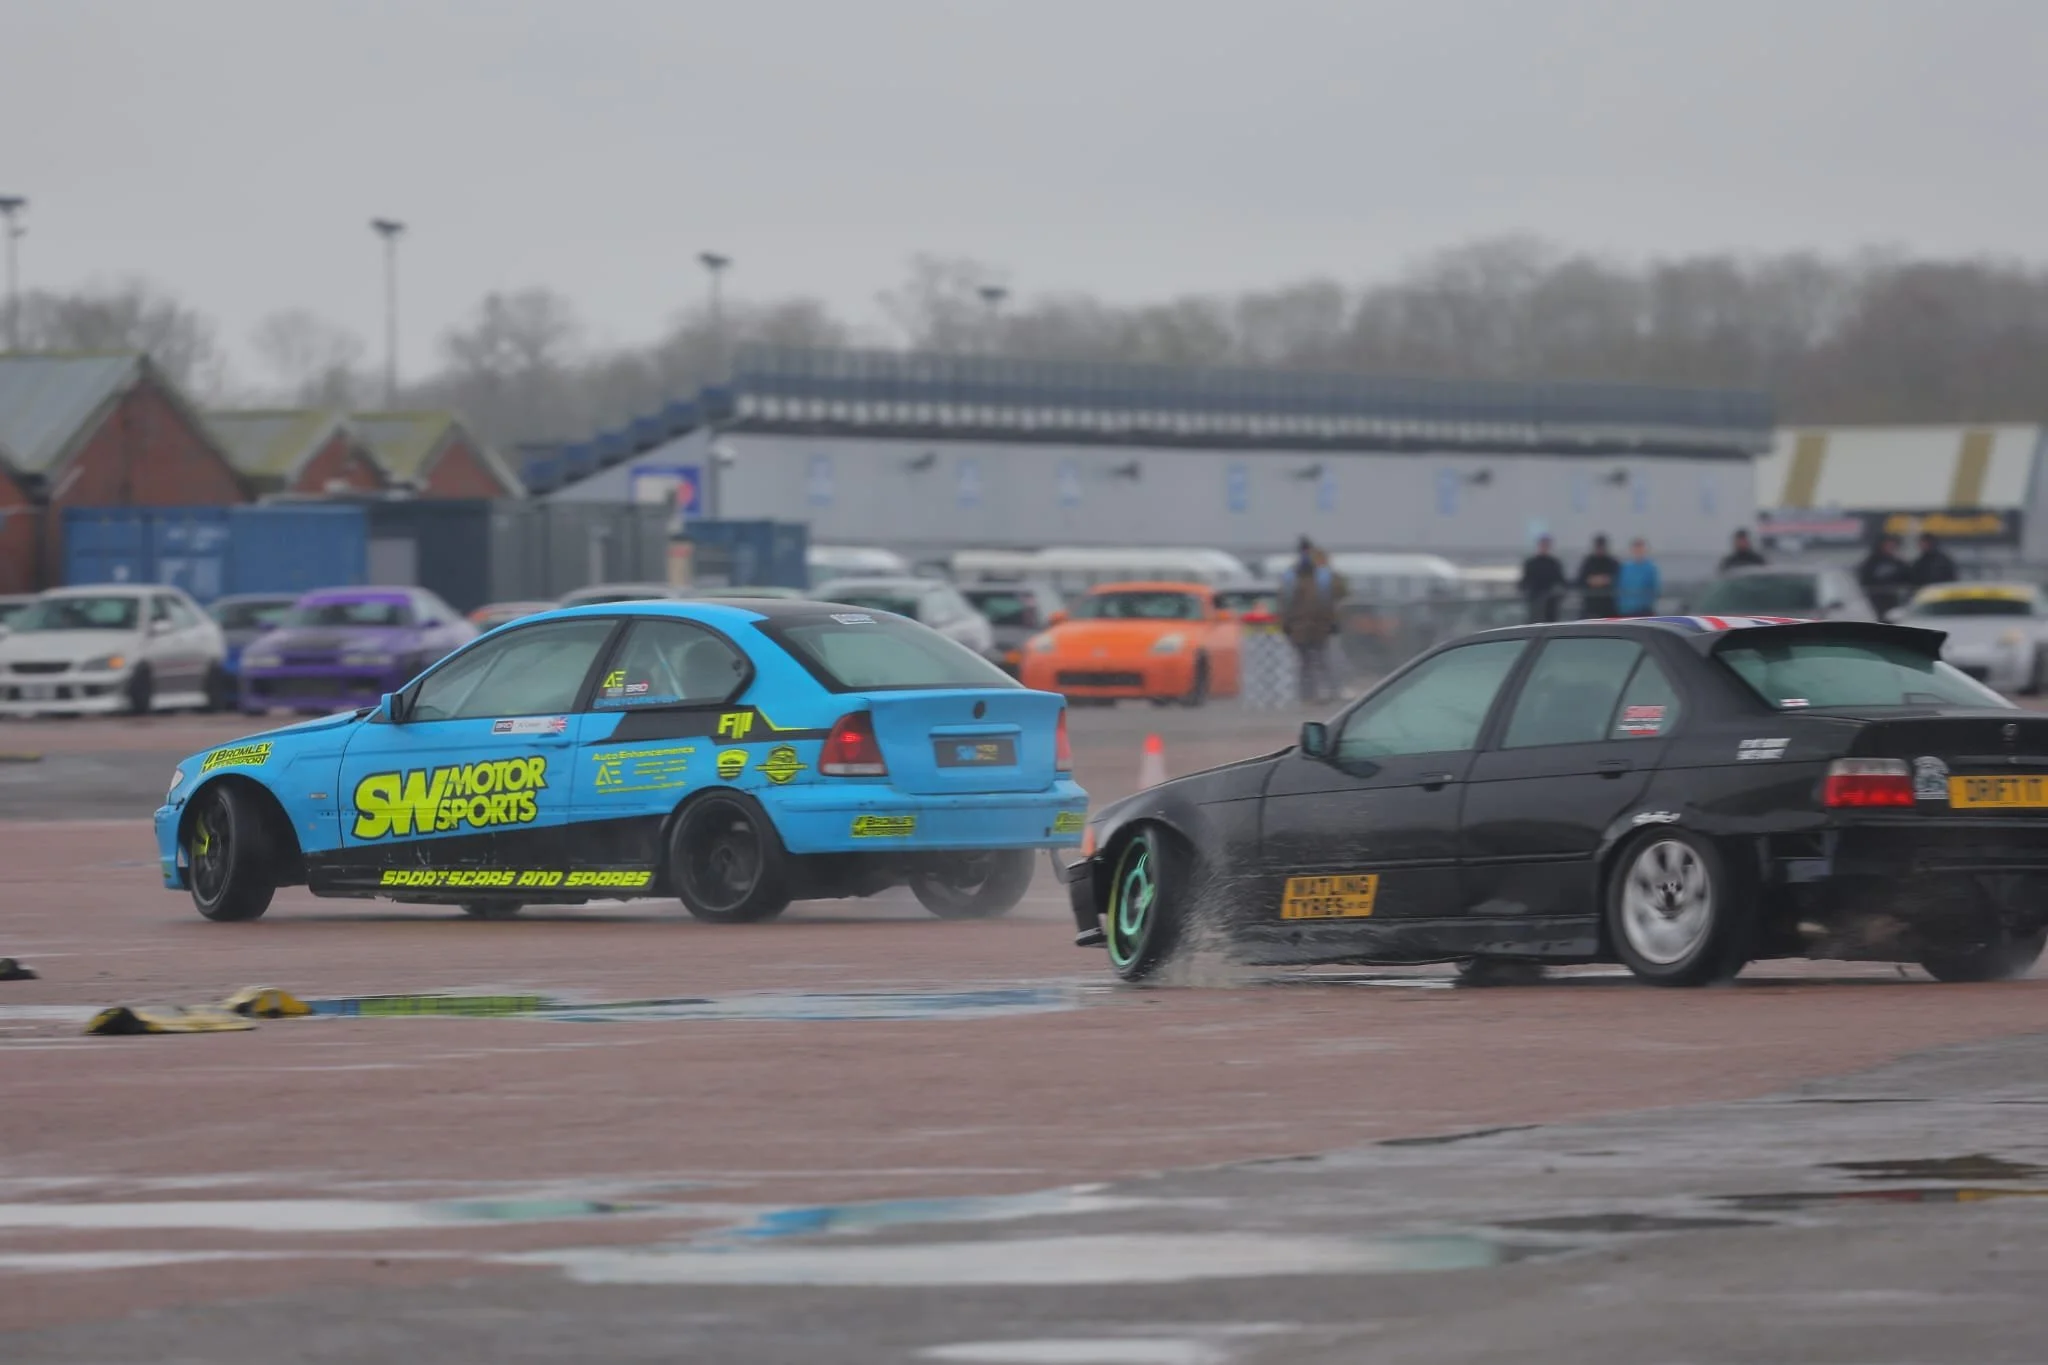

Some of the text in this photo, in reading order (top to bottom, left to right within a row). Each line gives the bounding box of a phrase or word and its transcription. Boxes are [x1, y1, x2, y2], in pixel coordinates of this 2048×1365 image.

[217, 743, 272, 760] BROMLEY
[444, 756, 547, 797] MOTOR
[353, 769, 450, 838] SW
[436, 791, 537, 830] SPORTS
[380, 871, 651, 886] SPORTSCARS AND SPARES
